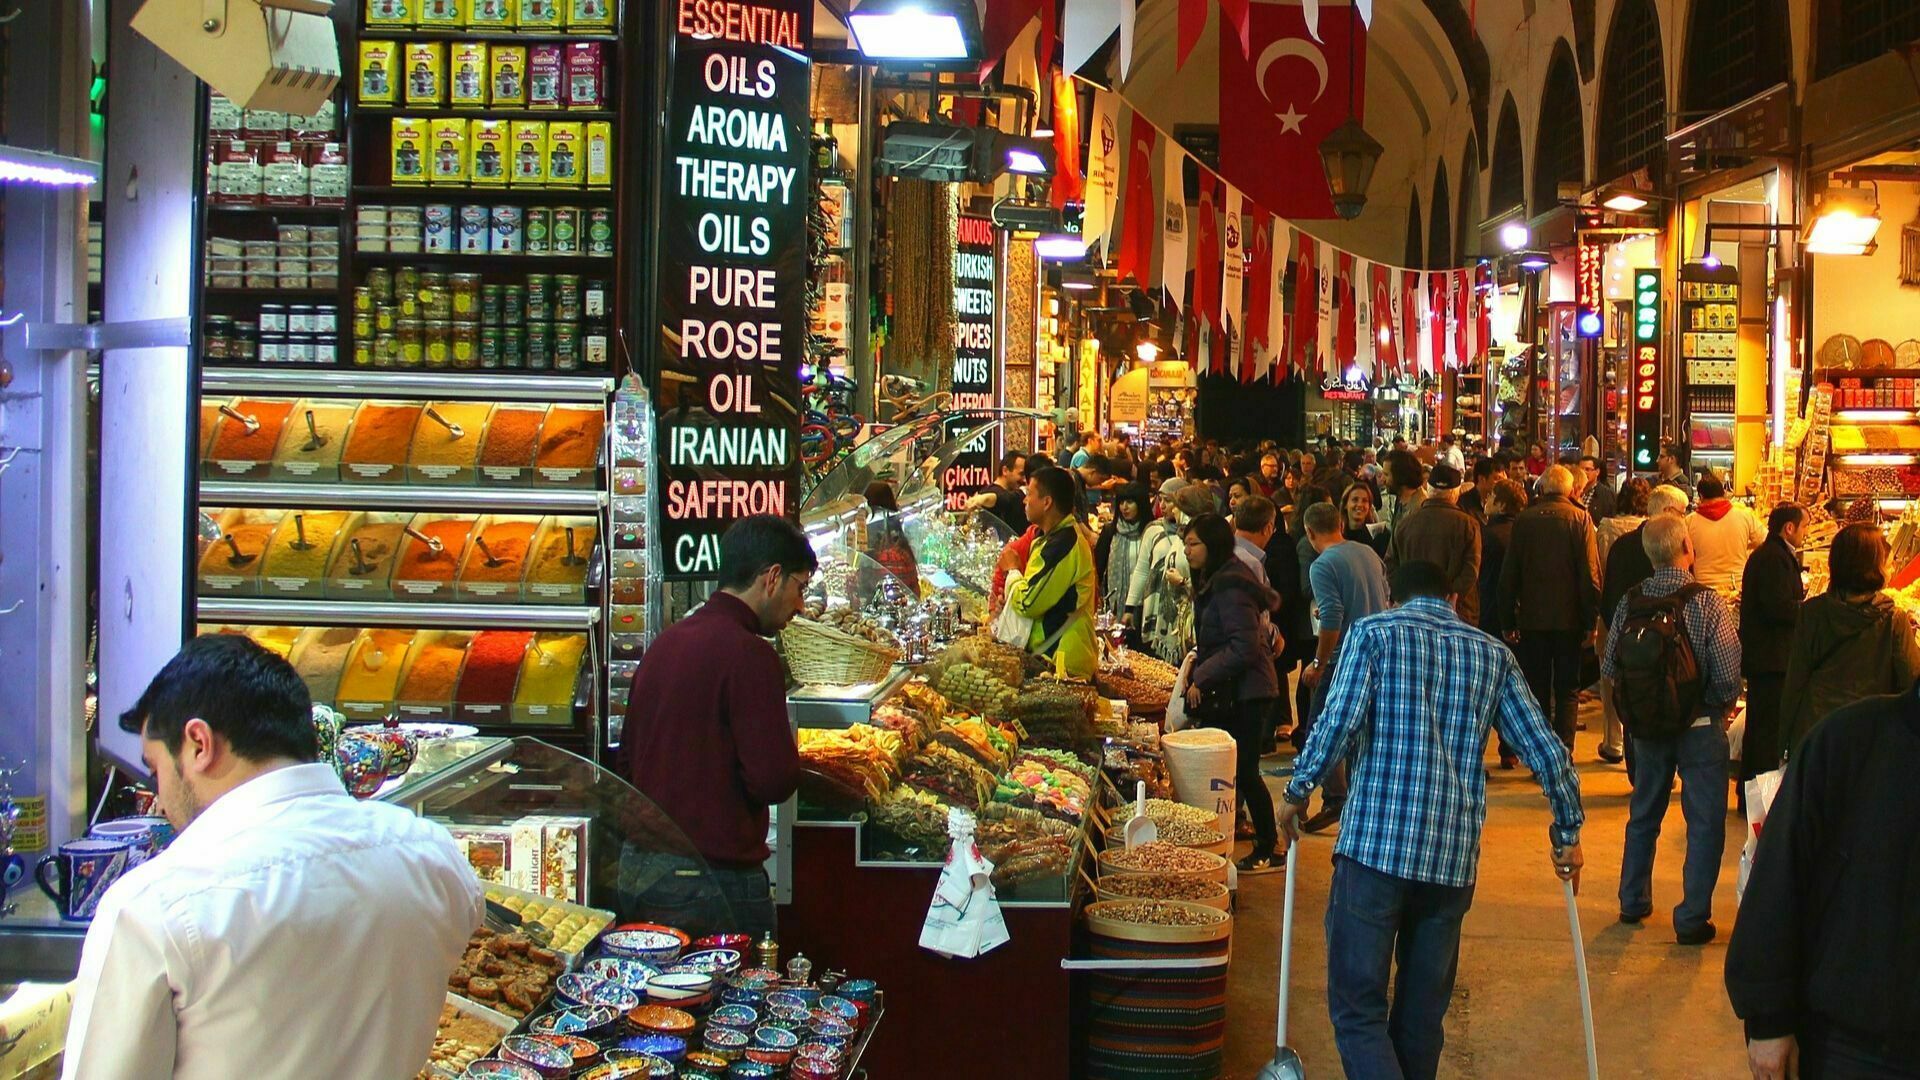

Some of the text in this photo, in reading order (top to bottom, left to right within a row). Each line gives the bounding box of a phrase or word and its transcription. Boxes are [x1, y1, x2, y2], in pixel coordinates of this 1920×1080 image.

[677, 0, 804, 49] ESSENTIAL
[704, 53, 777, 98] OILS
[686, 105, 788, 153] AROMA
[675, 157, 796, 205] THERAPY
[697, 213, 771, 257] OILS
[689, 265, 776, 309] PURE
[956, 253, 993, 281] URKISH
[956, 287, 993, 316] WEETS
[681, 319, 782, 361] ROSE
[953, 357, 988, 384] NUTS
[1081, 343, 1093, 423] HAYAT
[708, 373, 762, 413] OIL
[1324, 391, 1366, 400] RESTAURANT
[670, 426, 786, 466] IRANIAN
[945, 463, 990, 490] ÇİKİTA
[668, 479, 785, 520] SAFFRON
